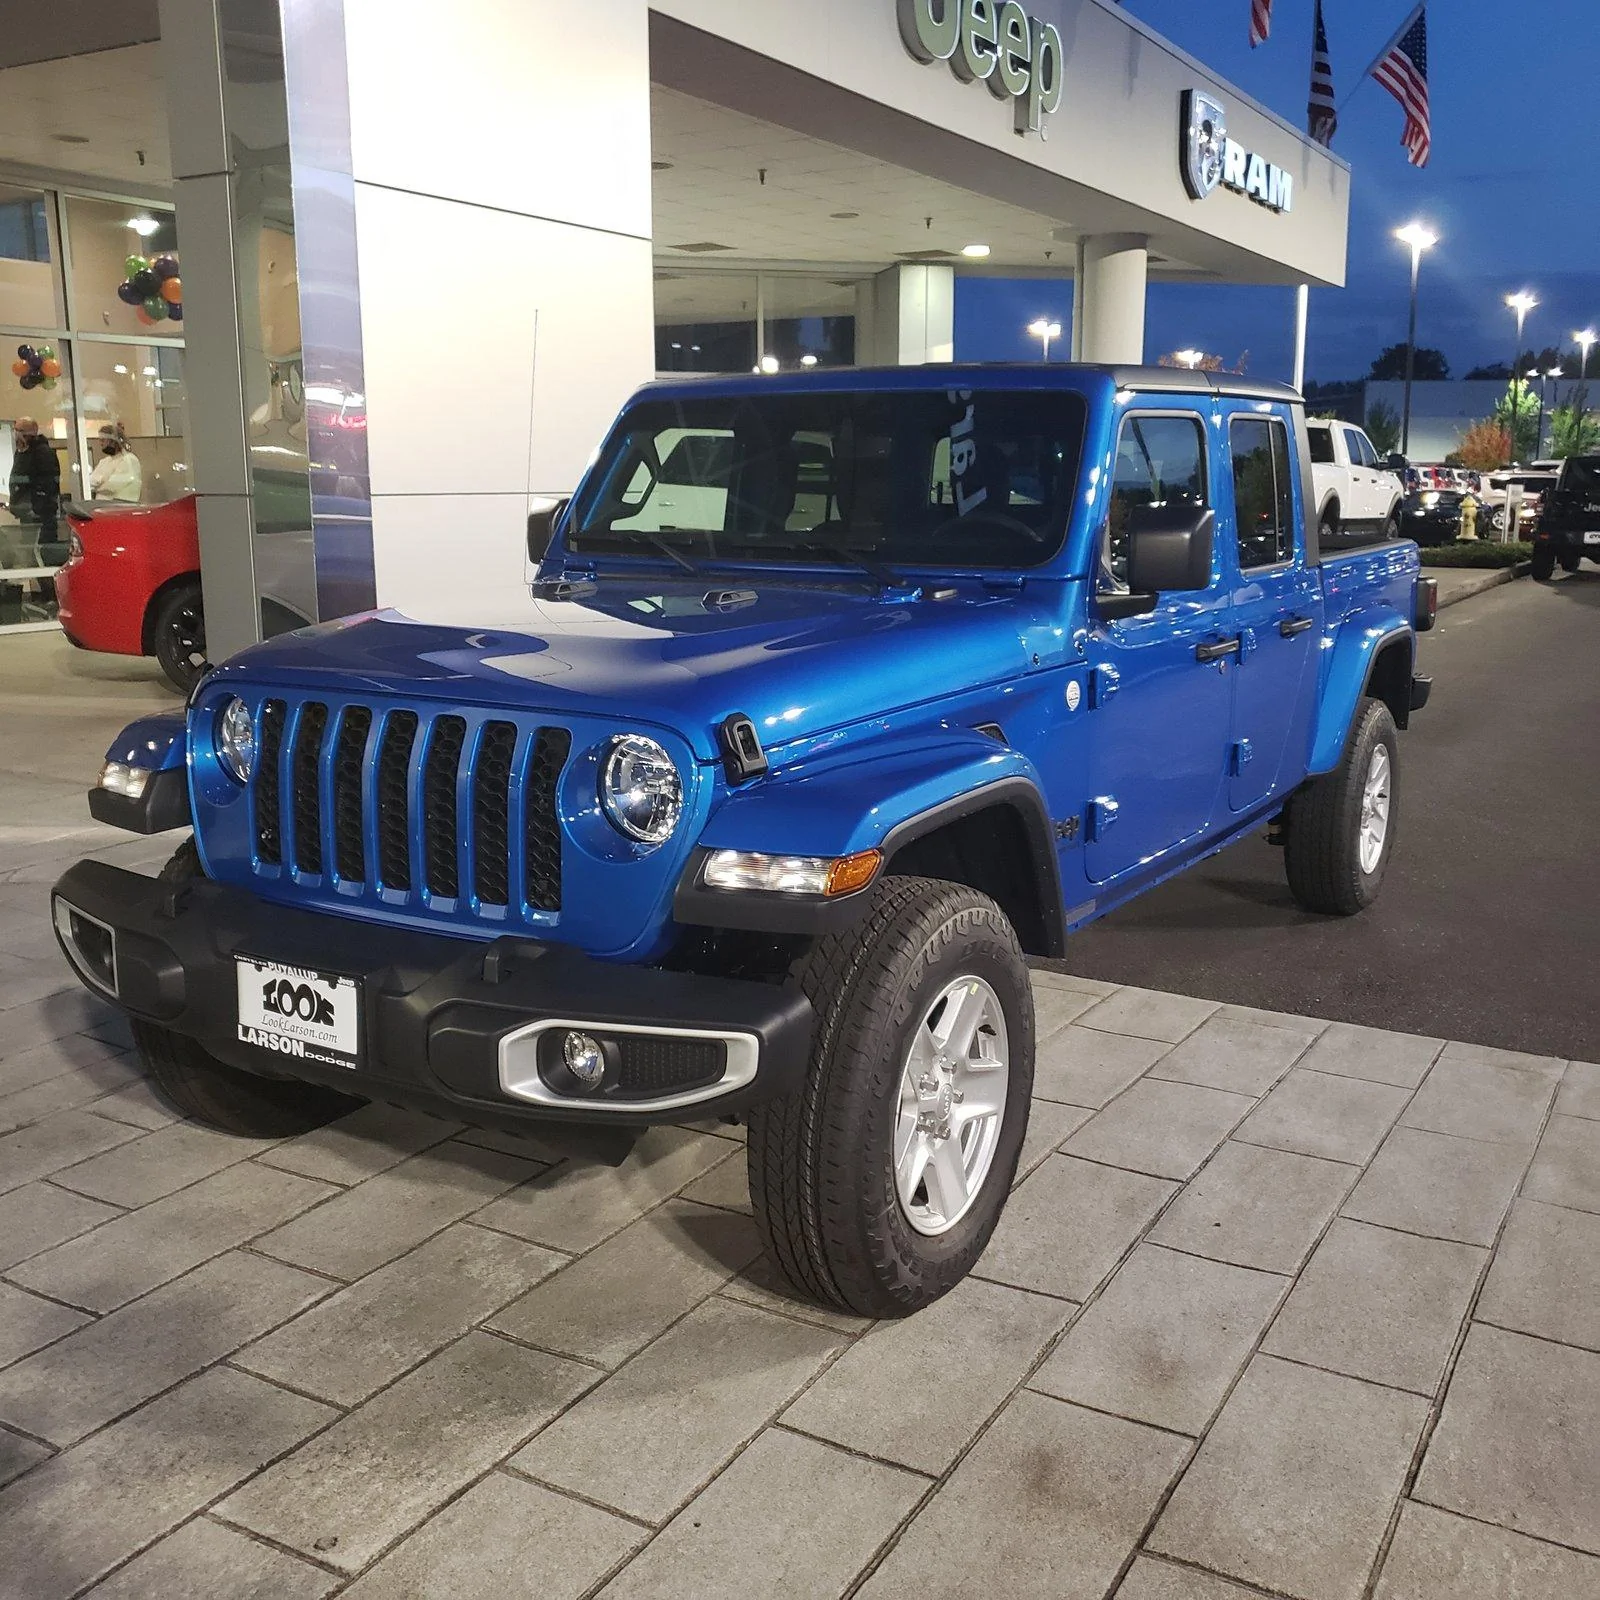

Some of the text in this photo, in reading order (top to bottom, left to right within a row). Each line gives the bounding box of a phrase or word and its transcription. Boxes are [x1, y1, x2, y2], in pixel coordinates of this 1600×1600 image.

[1223, 138, 1293, 213] RAM
[267, 961, 318, 980] PUYALLUP
[237, 1024, 356, 1069] LARSON DODGE
[261, 1014, 338, 1043] LookLarson.com
